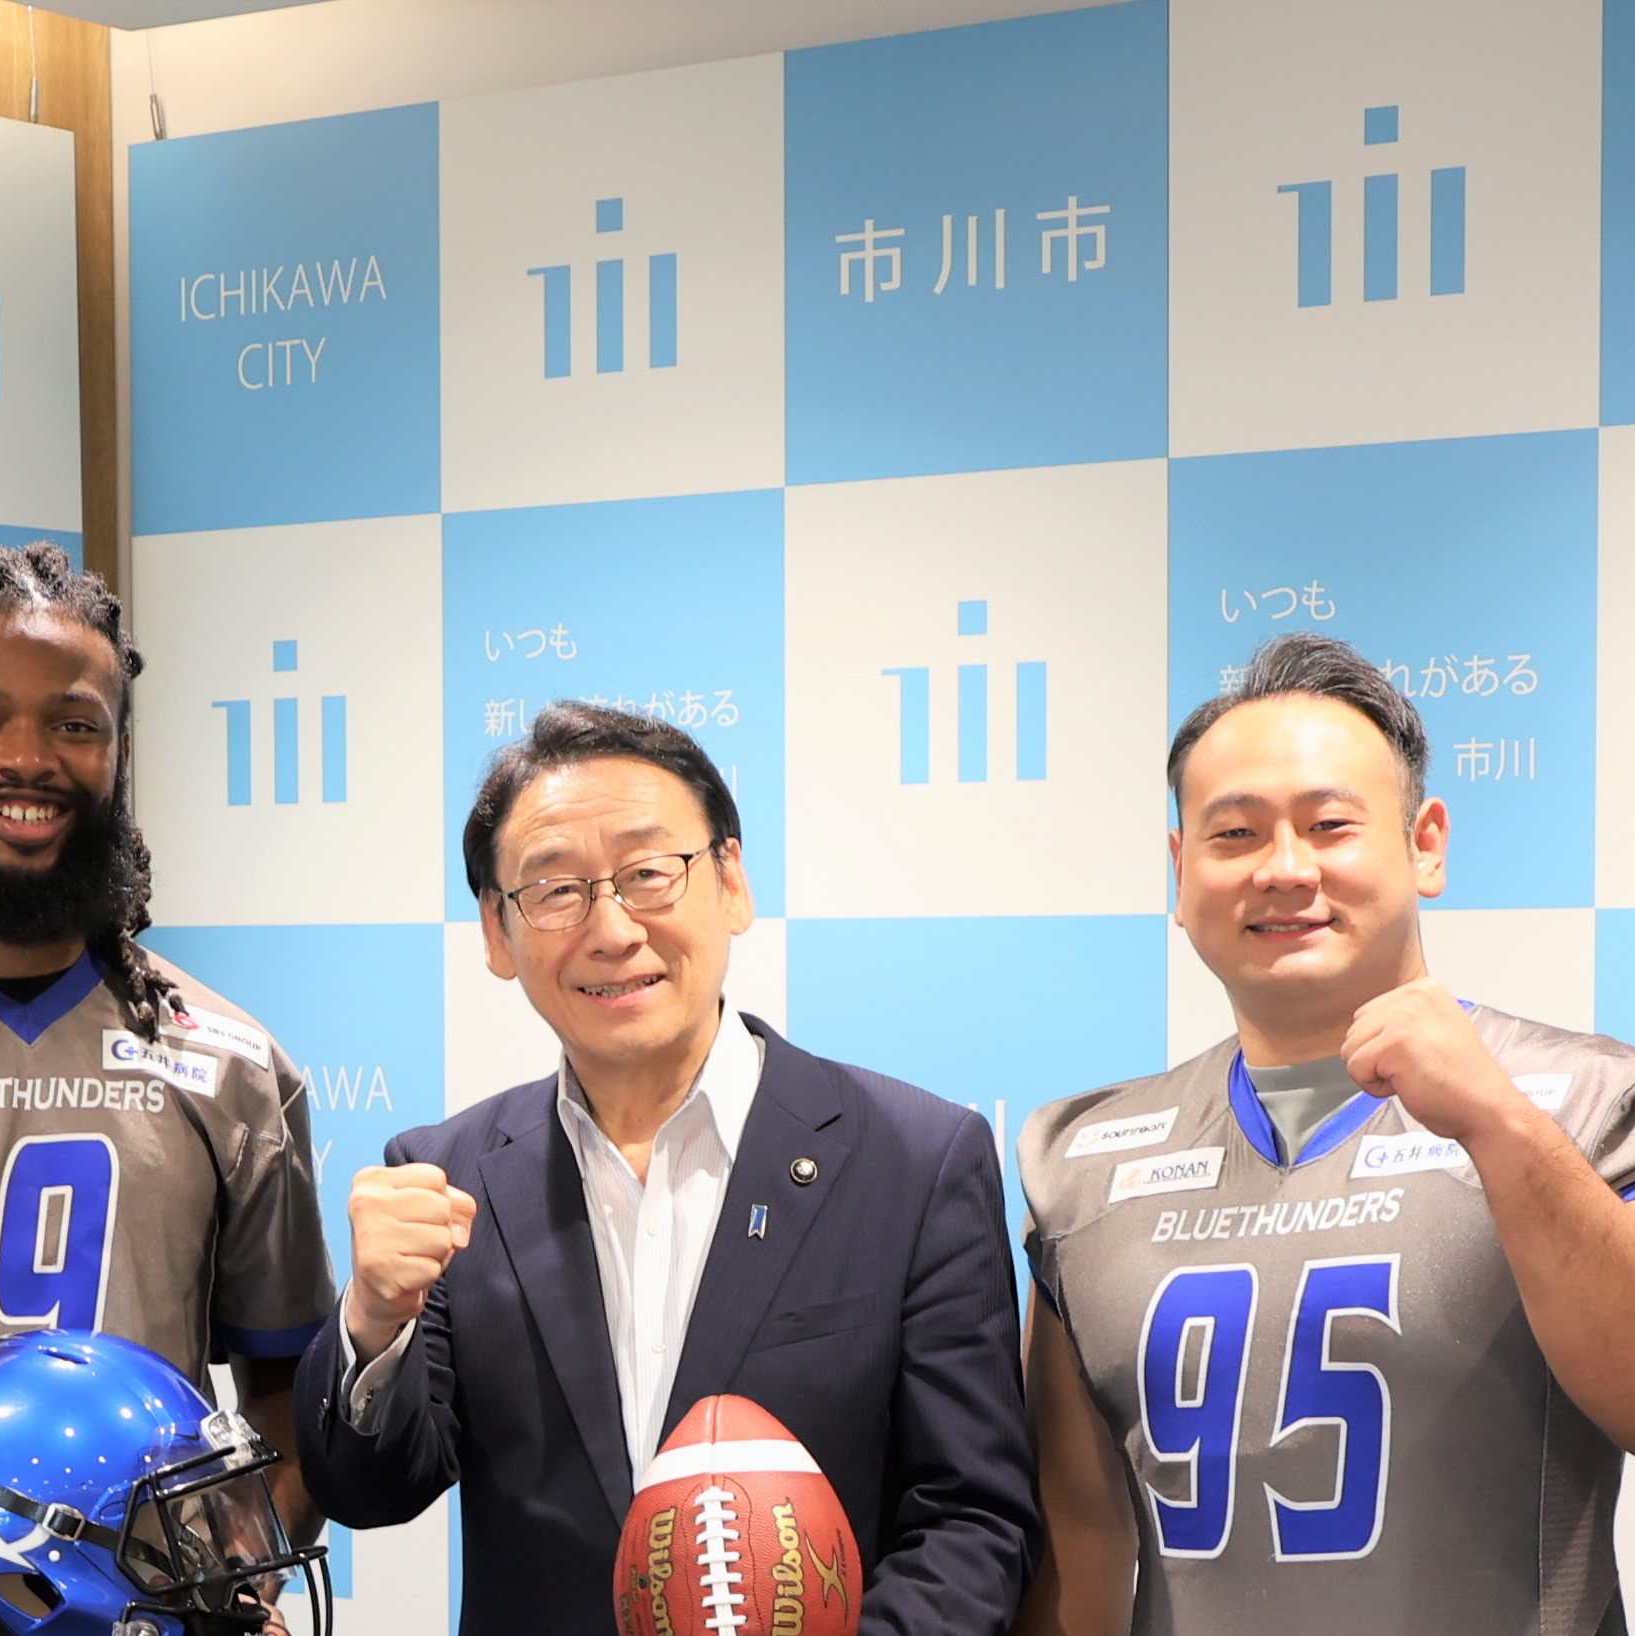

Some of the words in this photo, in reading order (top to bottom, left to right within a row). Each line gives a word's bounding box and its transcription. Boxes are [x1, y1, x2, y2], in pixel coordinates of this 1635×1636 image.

[834, 194, 1111, 304] 市川市
[177, 254, 388, 323] ICHIKAWA
[236, 336, 327, 391] CITY
[1220, 579, 1337, 624] いつも
[484, 622, 578, 662] いつも
[1452, 736, 1538, 783] 市川
[140, 1045, 208, 1084] 五井病院
[227, 1032, 262, 1052] GROUP
[1148, 1160, 1210, 1182] KONAN
[1150, 1188, 1406, 1244] BLUETHUNDERS
[1136, 1252, 1404, 1563] 95
